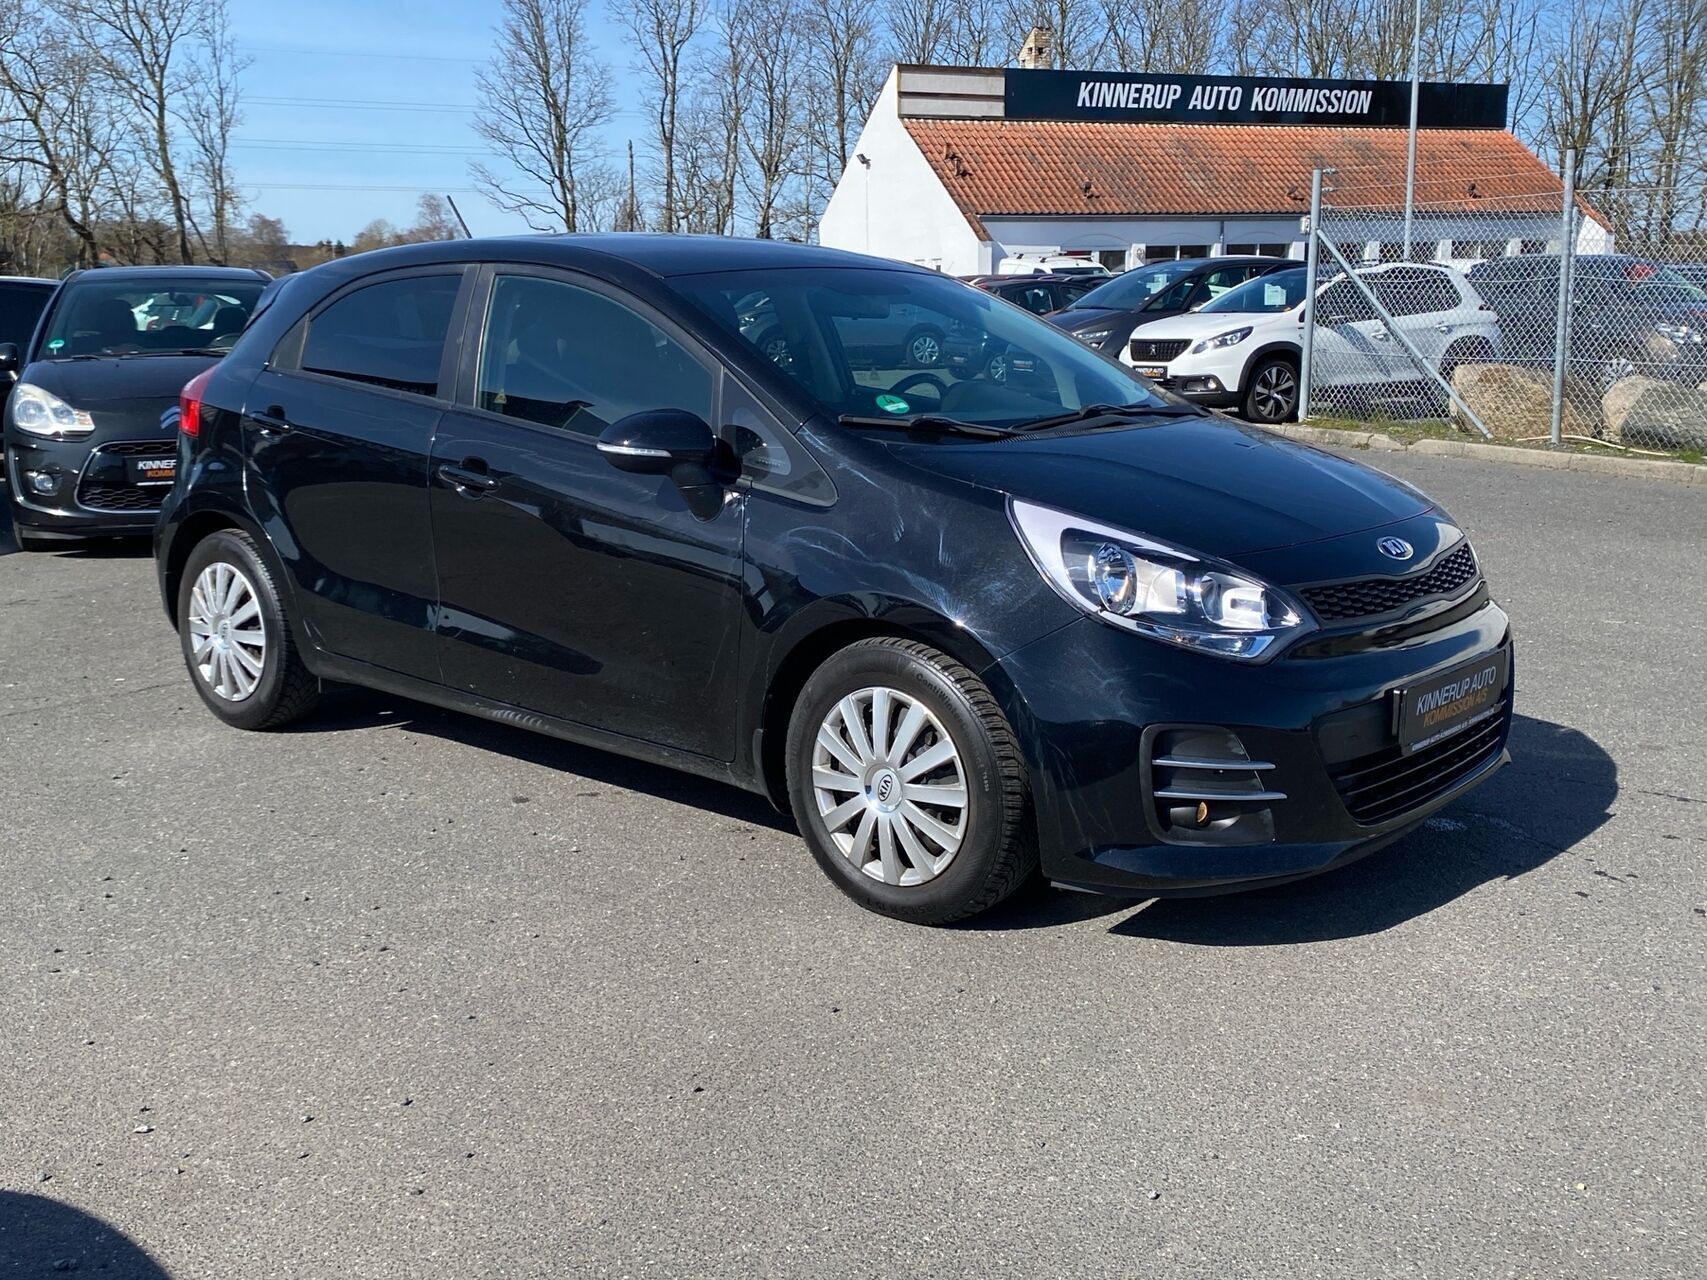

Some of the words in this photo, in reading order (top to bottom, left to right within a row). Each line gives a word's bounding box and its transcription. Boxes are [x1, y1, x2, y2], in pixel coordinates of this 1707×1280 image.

[1077, 82, 1182, 109] KINNERUP
[1188, 85, 1243, 110] AUTO
[1250, 87, 1373, 114] KOMMISSION
[1416, 677, 1470, 716] KINNERUP
[1469, 666, 1497, 694] AUTO
[879, 779, 891, 799] KIA
